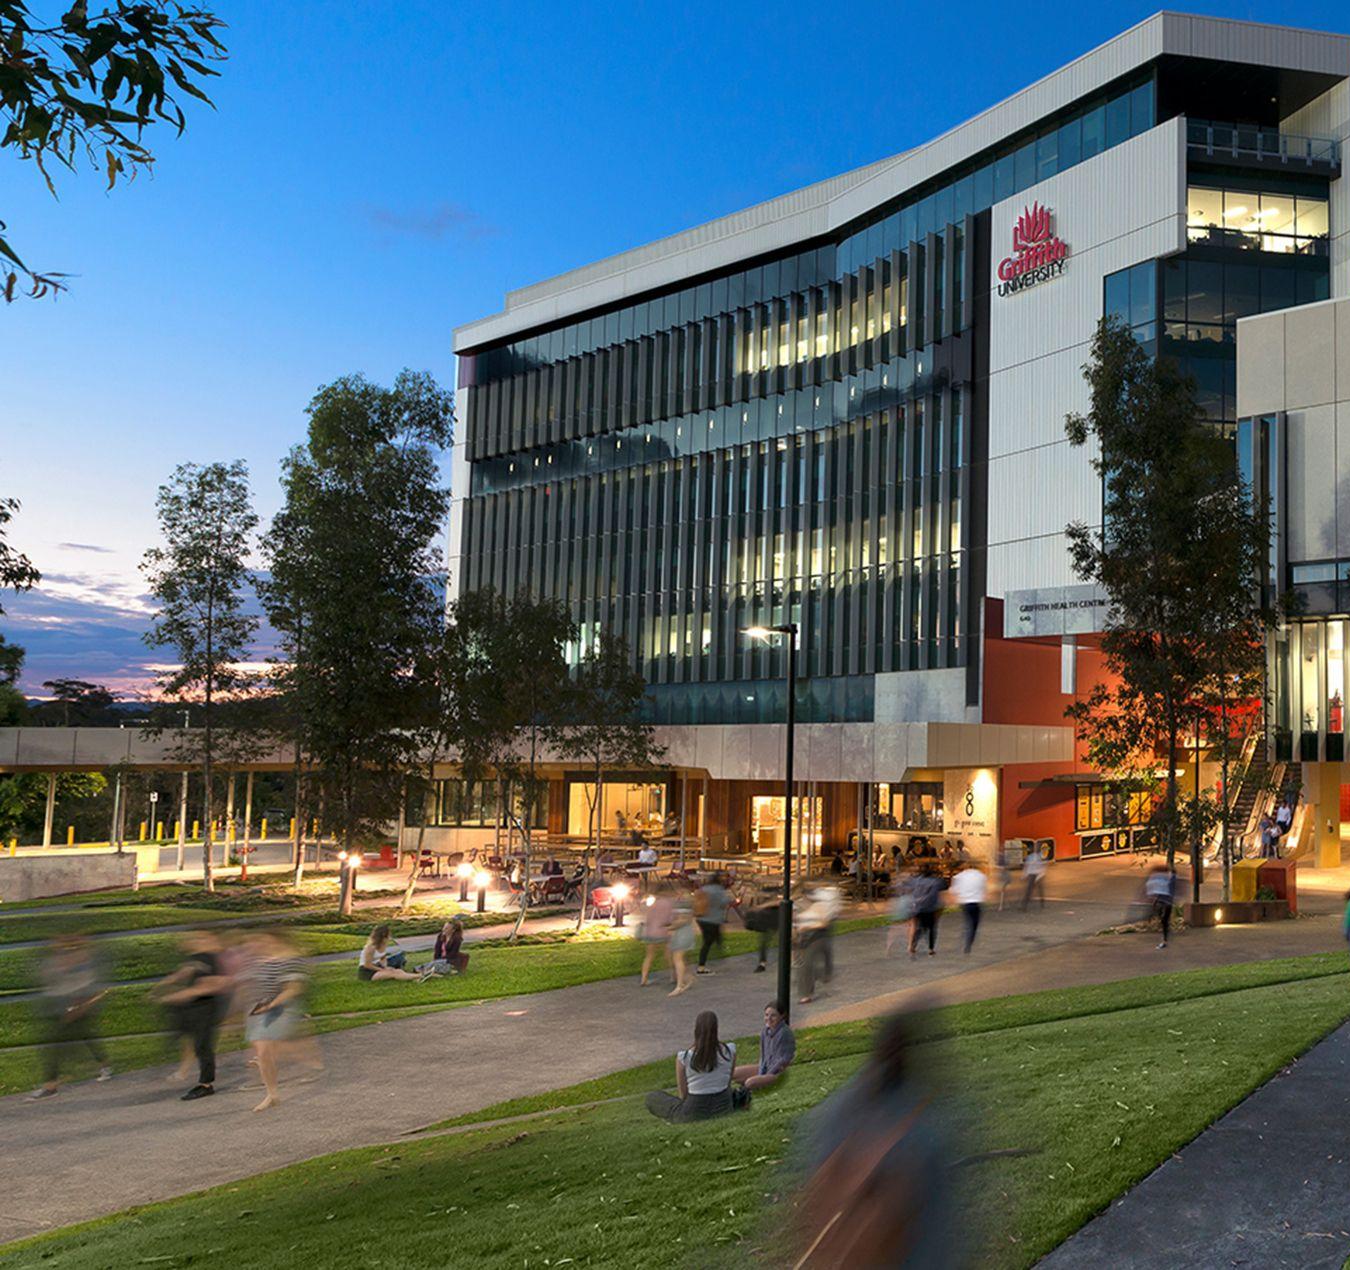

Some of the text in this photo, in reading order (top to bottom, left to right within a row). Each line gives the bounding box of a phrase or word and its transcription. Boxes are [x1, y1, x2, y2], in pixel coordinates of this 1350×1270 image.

[997, 237, 1067, 281] Griffith
[998, 259, 1065, 297] UNIVERSITY
[1019, 599, 1106, 612] GRIFFITH HEALTH CENTRE
